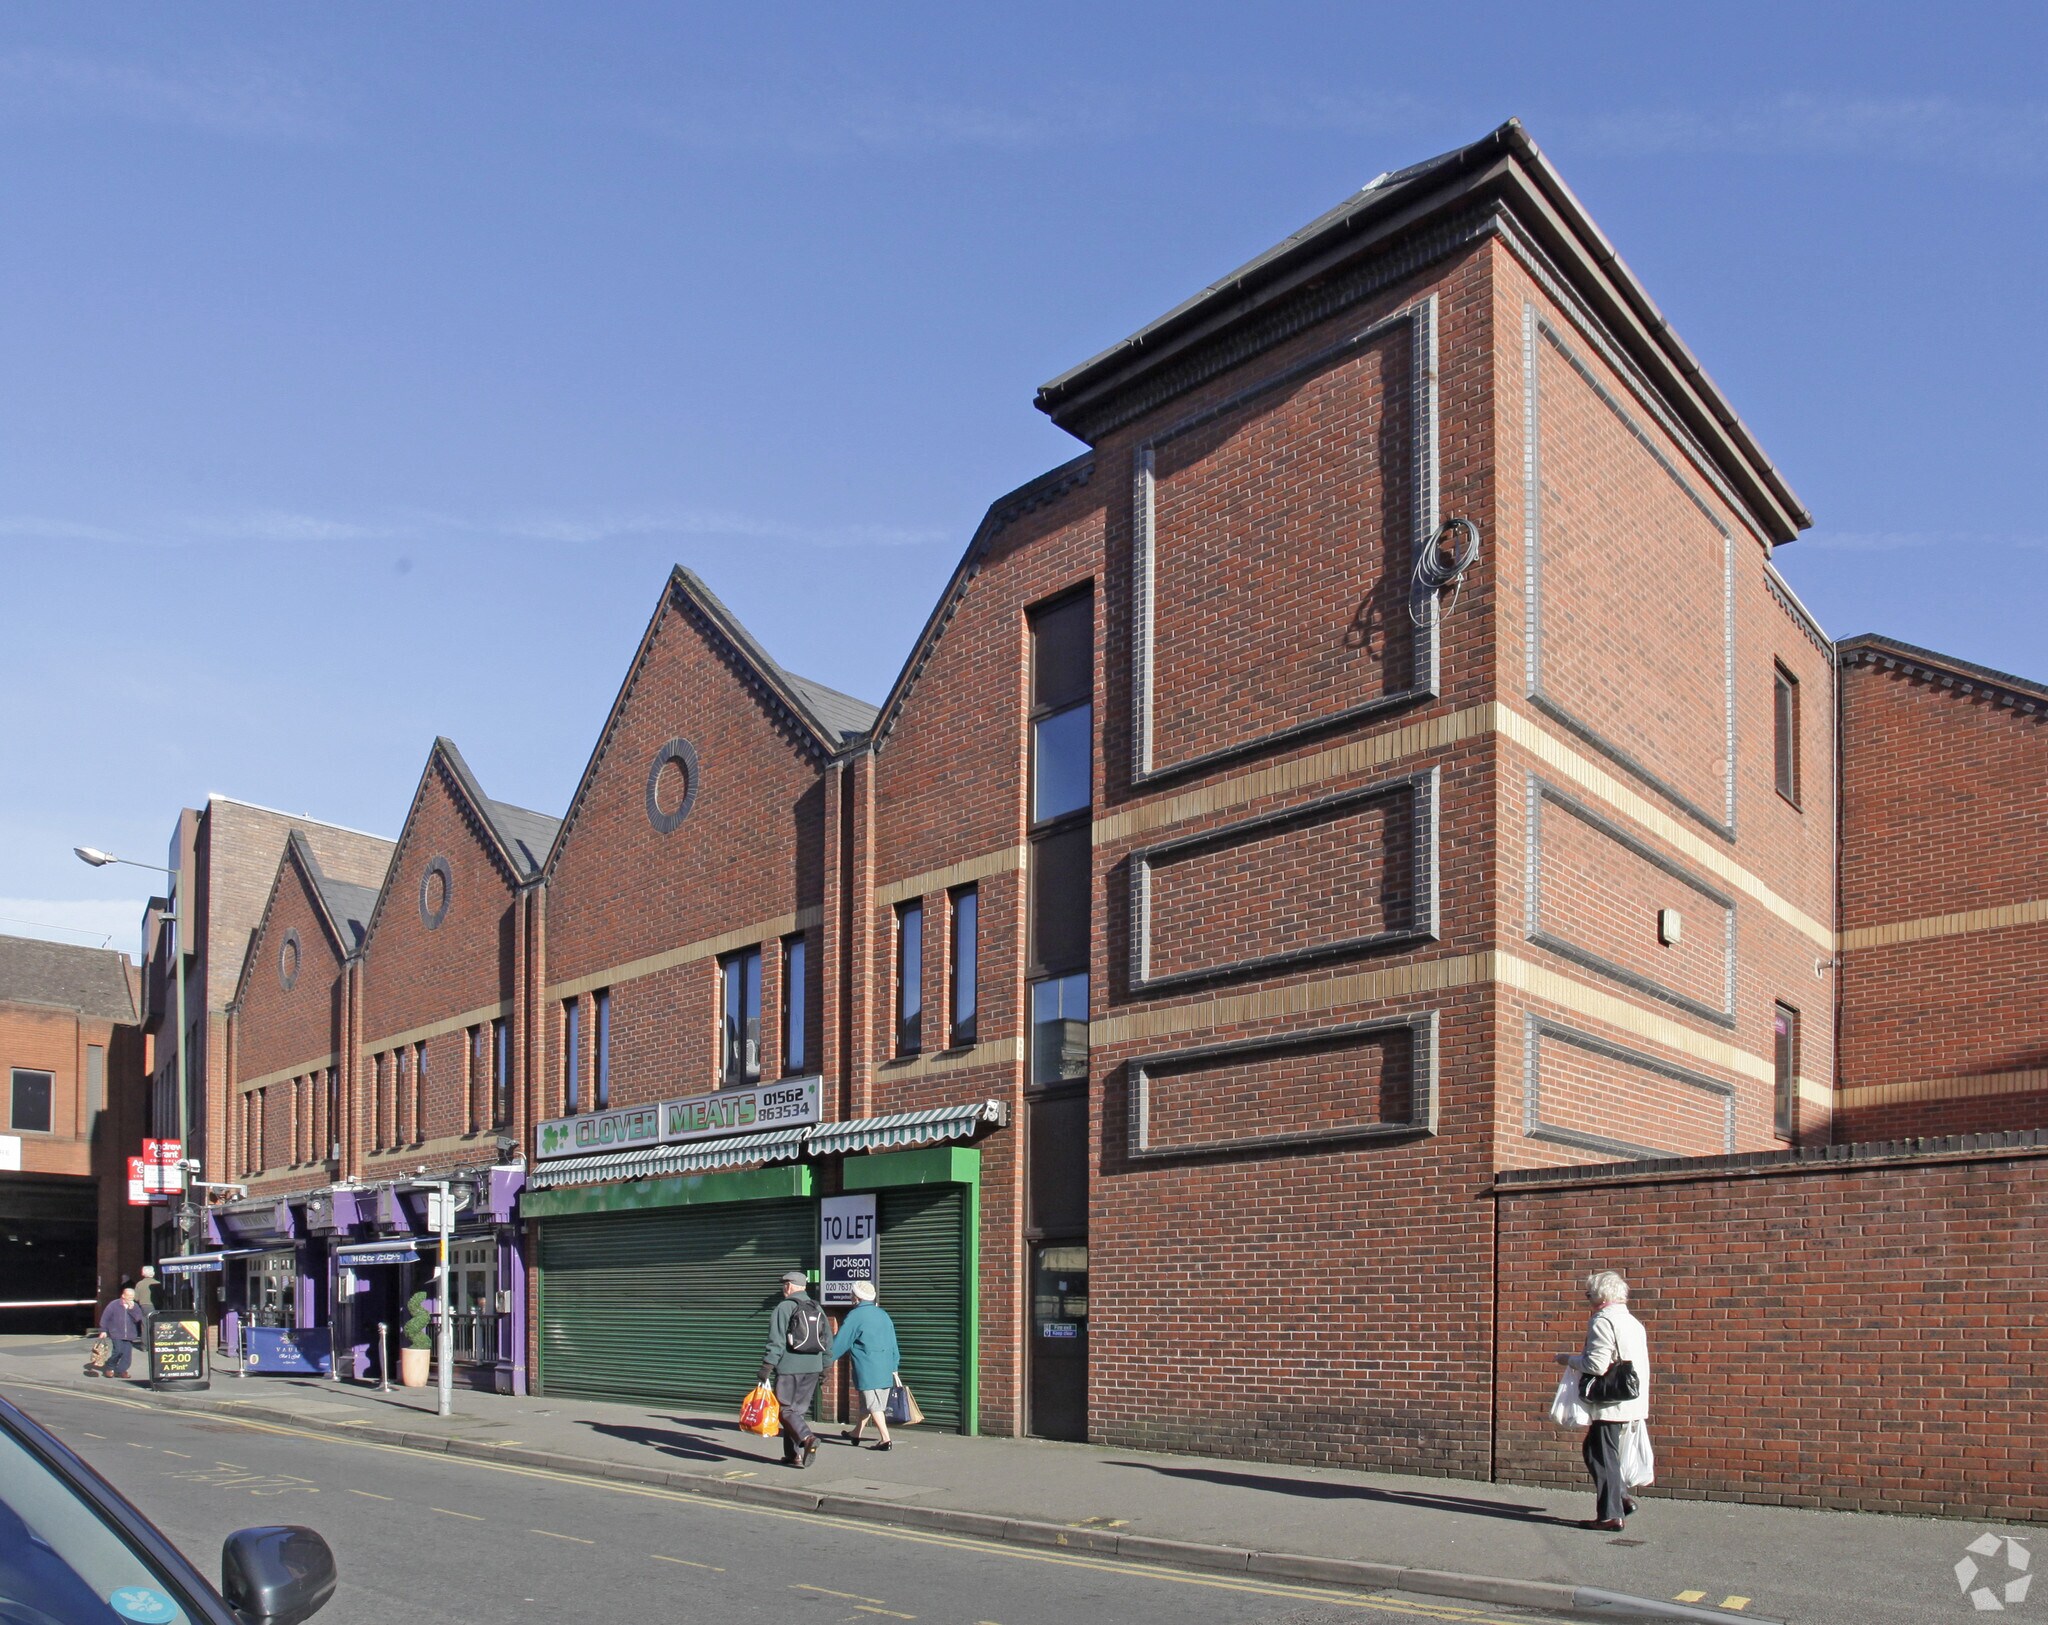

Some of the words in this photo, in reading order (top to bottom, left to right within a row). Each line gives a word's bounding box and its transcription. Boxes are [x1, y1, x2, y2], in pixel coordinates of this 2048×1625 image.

[763, 1088, 803, 1106] 01562
[758, 1102, 810, 1121] 863534
[575, 1110, 658, 1148] CLOVER
[669, 1093, 757, 1135] MEATS
[149, 1141, 181, 1150] Andrew
[153, 1150, 179, 1158] Grant
[824, 1217, 842, 1240] TO
[846, 1215, 873, 1239] LET
[833, 1257, 870, 1269] jackson
[847, 1267, 870, 1278] criss
[825, 1282, 837, 1291] 020
[838, 1282, 852, 1291] 7637
[160, 1353, 191, 1363] £2.00
